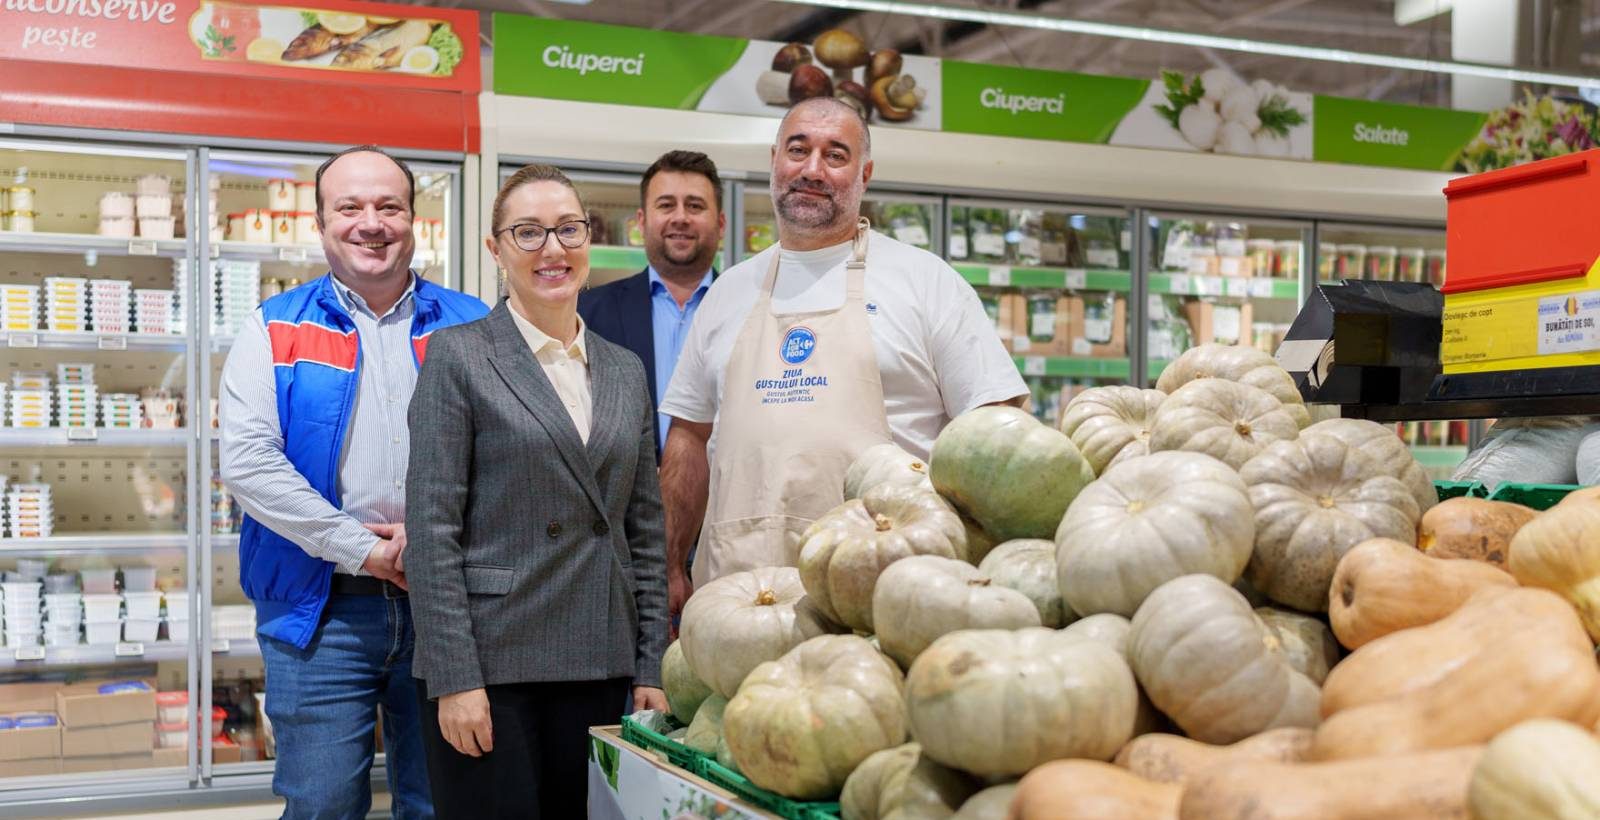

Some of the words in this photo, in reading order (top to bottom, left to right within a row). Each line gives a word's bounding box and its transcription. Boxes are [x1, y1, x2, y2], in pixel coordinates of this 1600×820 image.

[22, 26, 96, 51] pește
[543, 45, 644, 75] Ciuperci
[980, 87, 1065, 114] Ciuperci
[1353, 122, 1409, 146] Salate
[1575, 319, 1582, 329] DE
[755, 378, 798, 389] GUSTULUI
[800, 376, 828, 387] LOCAL
[783, 369, 802, 379] ZIUA
